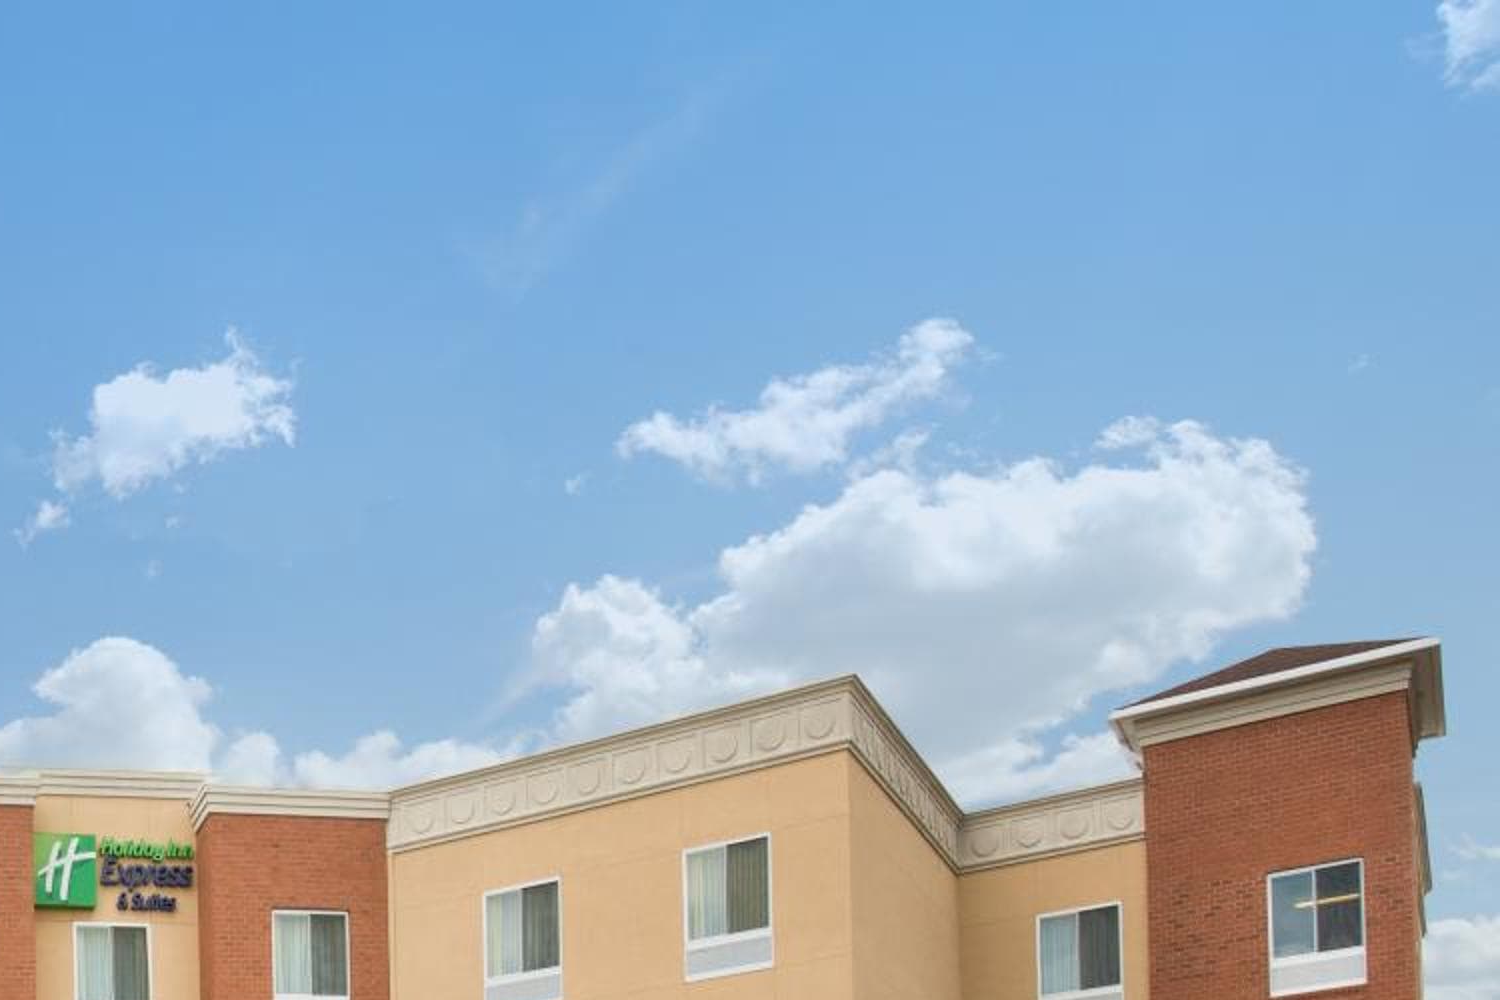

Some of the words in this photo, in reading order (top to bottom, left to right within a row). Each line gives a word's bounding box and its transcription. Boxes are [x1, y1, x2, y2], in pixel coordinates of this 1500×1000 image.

[100, 838, 164, 862] Holiday
[167, 840, 193, 859] Inn
[101, 855, 193, 891] Express
[117, 892, 128, 910] &
[131, 893, 175, 911] Suites
